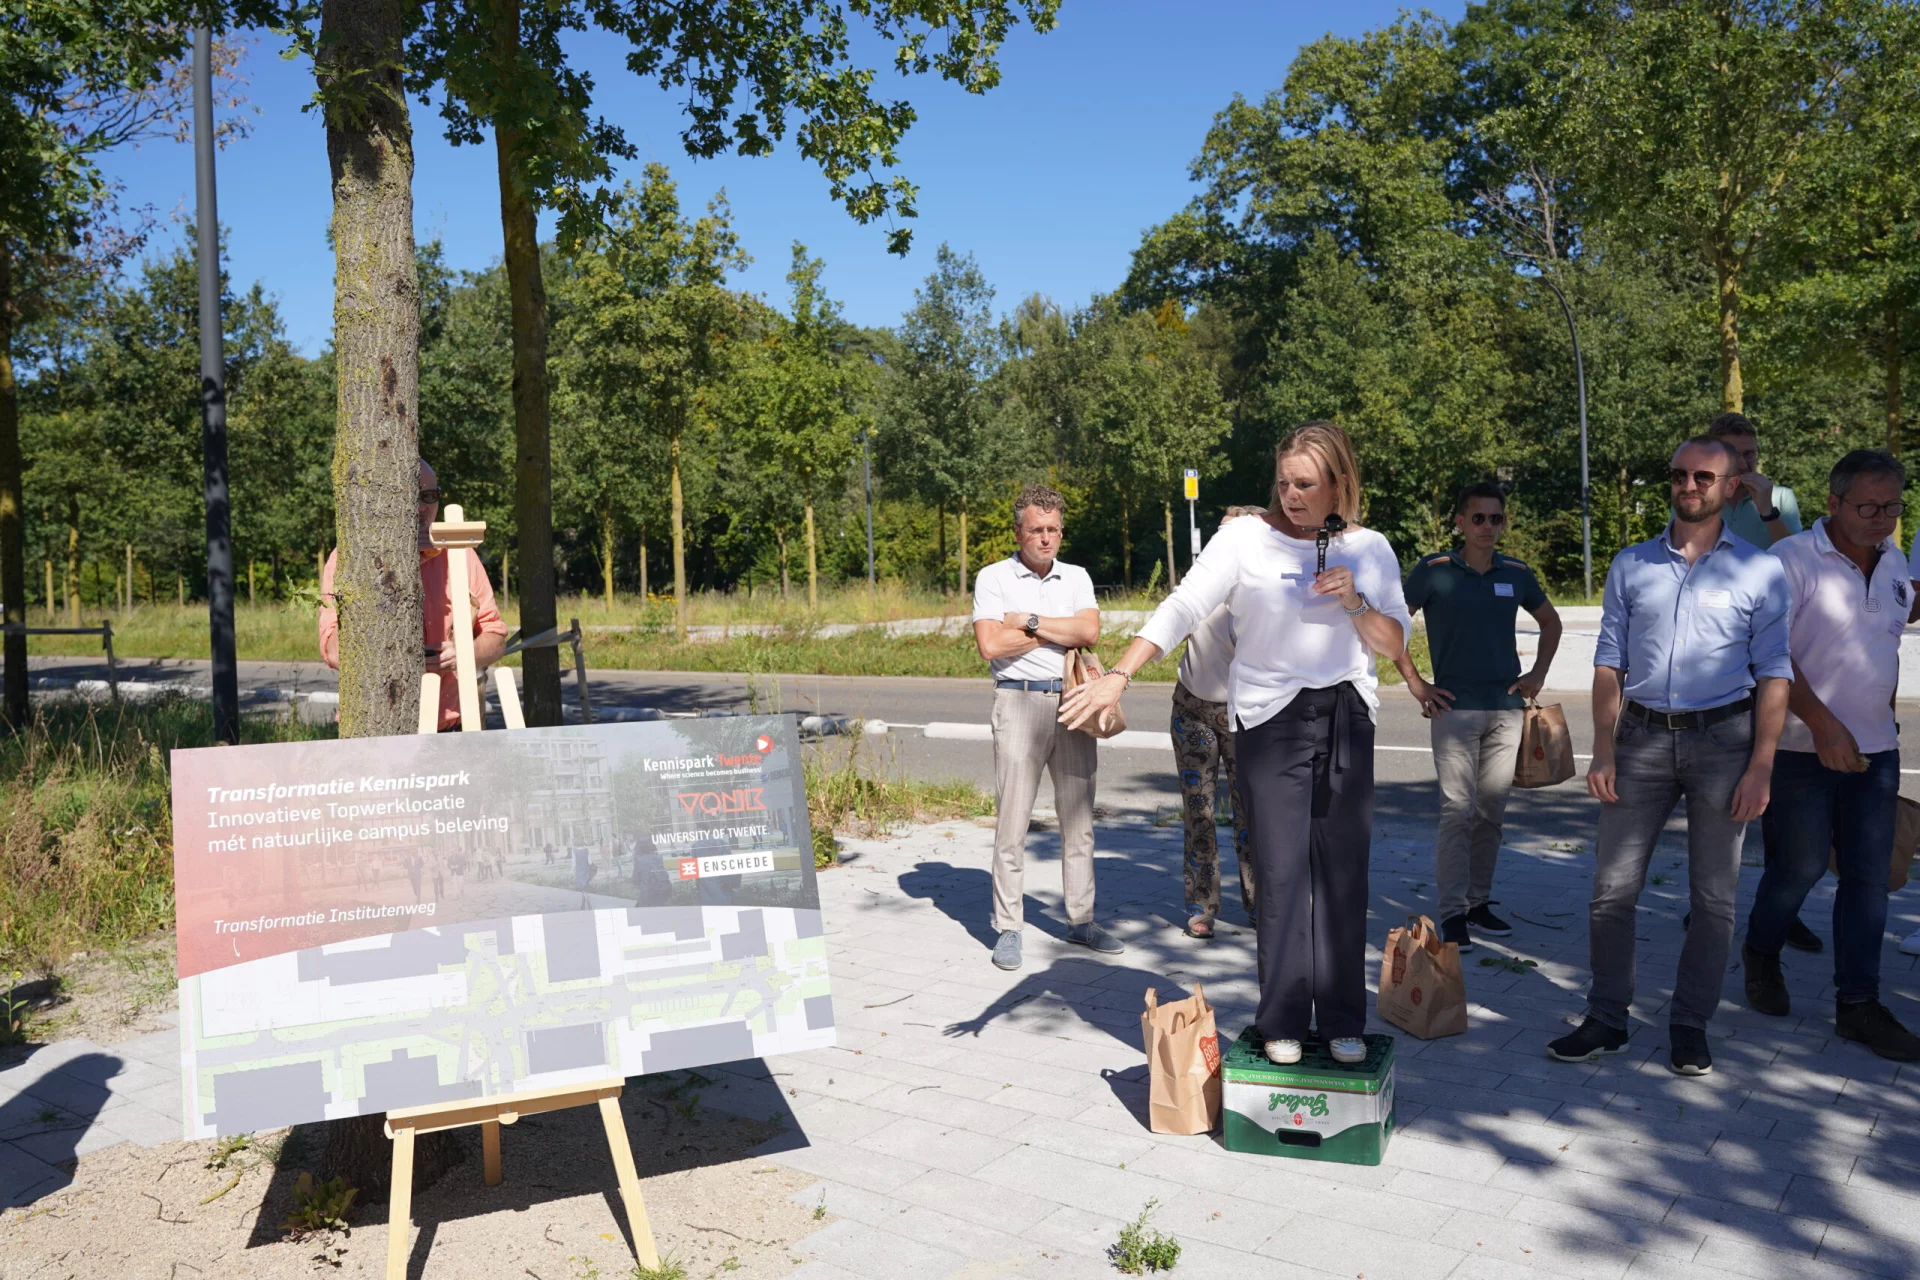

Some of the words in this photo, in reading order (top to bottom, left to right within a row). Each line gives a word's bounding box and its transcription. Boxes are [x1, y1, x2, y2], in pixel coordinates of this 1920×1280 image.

[643, 754, 714, 771] Kennispark
[716, 753, 762, 766] Twente
[660, 772, 681, 780] Where
[682, 770, 705, 779] science
[706, 768, 733, 777] becomes
[733, 767, 762, 775] business!
[207, 778, 355, 803] Transformatie
[359, 770, 471, 792] Kennispark
[207, 806, 322, 828] Innovatieve
[326, 794, 465, 821] Topwerklocatie
[677, 787, 767, 815] VONK
[208, 833, 247, 853] mét
[252, 827, 353, 849] natuurlijke
[358, 823, 431, 841] campus
[435, 815, 509, 834] beleving
[651, 830, 710, 845] UNIVERSITY
[712, 828, 726, 839] OF
[727, 825, 771, 838] TWENTE.
[703, 856, 769, 873] ENSCHEDE
[214, 910, 325, 934] Transformatie
[328, 902, 436, 923] Institutenweg
[1267, 1092, 1330, 1118] Grolsch
